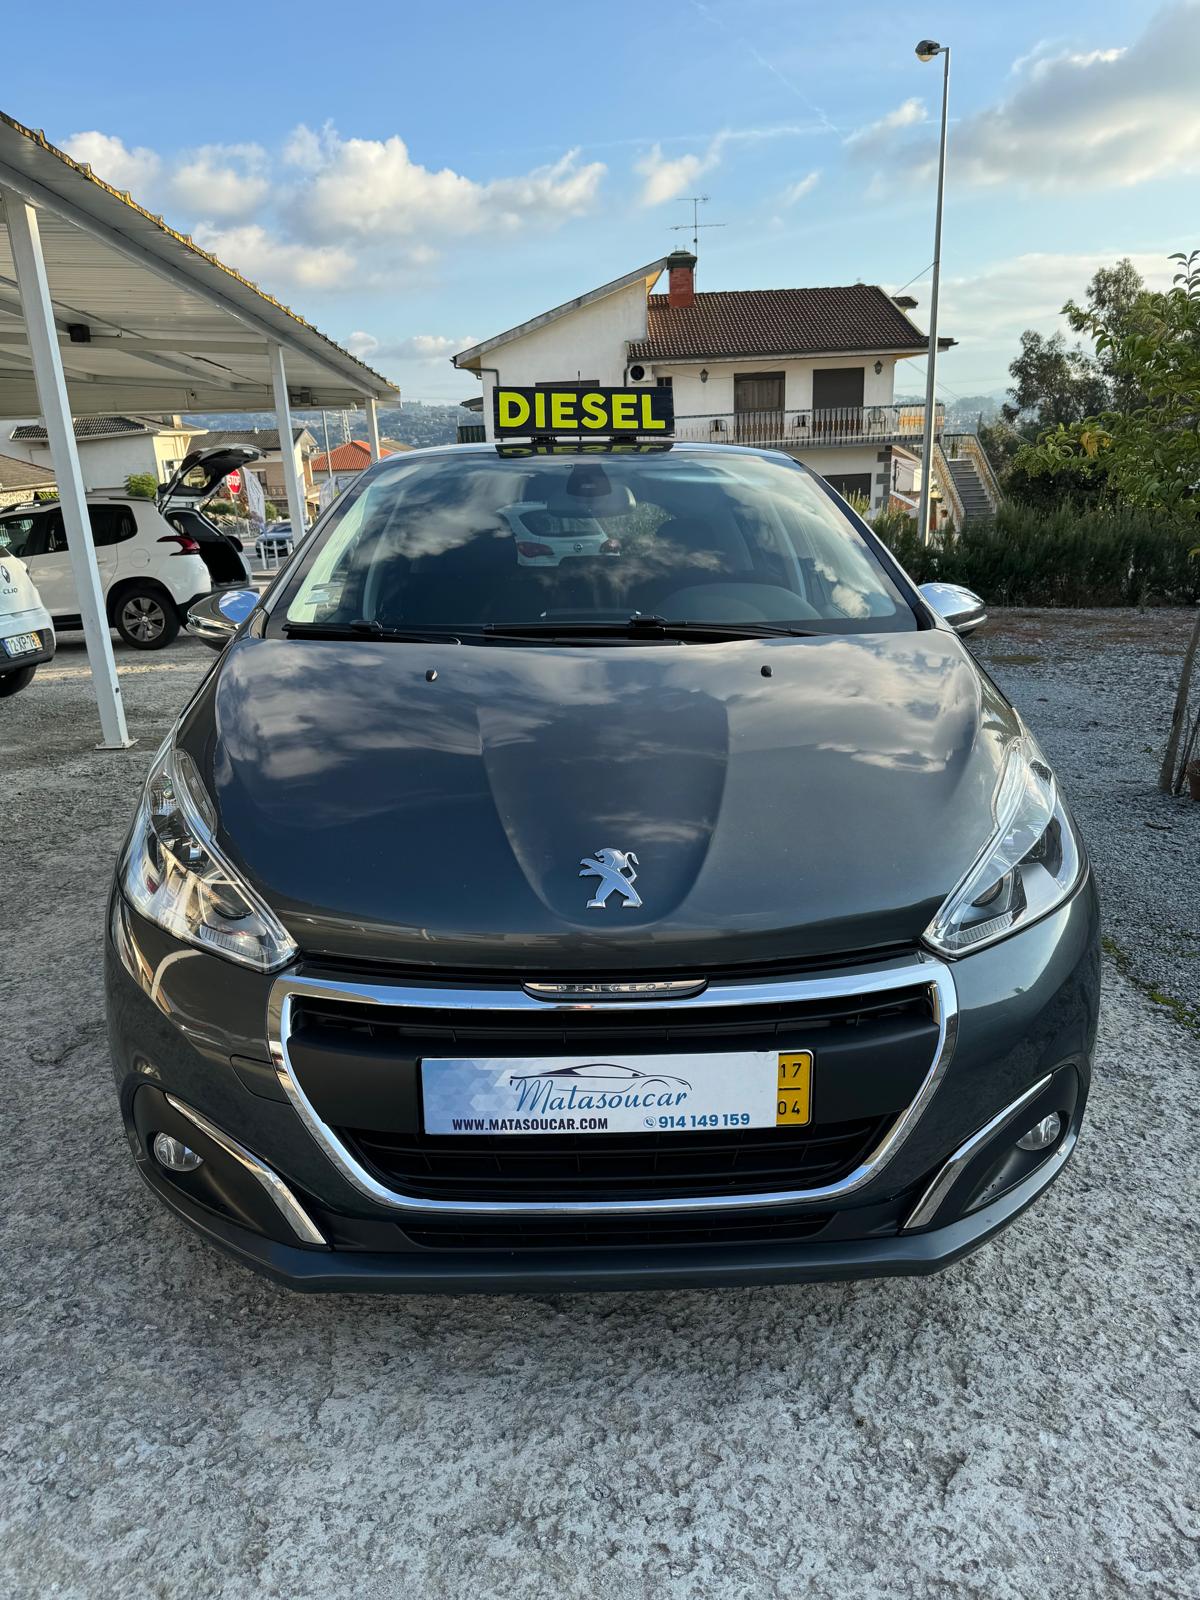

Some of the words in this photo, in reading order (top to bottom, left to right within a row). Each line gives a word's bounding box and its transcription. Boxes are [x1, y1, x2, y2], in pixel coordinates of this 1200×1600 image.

[498, 391, 666, 429] DIESEL
[227, 475, 240, 486] STOP
[3, 587, 18, 595] CLIO
[780, 1063, 802, 1078] 17
[515, 1078, 688, 1114] Matasoucar
[778, 1101, 800, 1115] 04
[452, 1117, 608, 1131] WWW.MATASOUCAR.COM
[658, 1115, 686, 1128] 914
[690, 1114, 719, 1127] 149
[722, 1113, 750, 1126] 159
